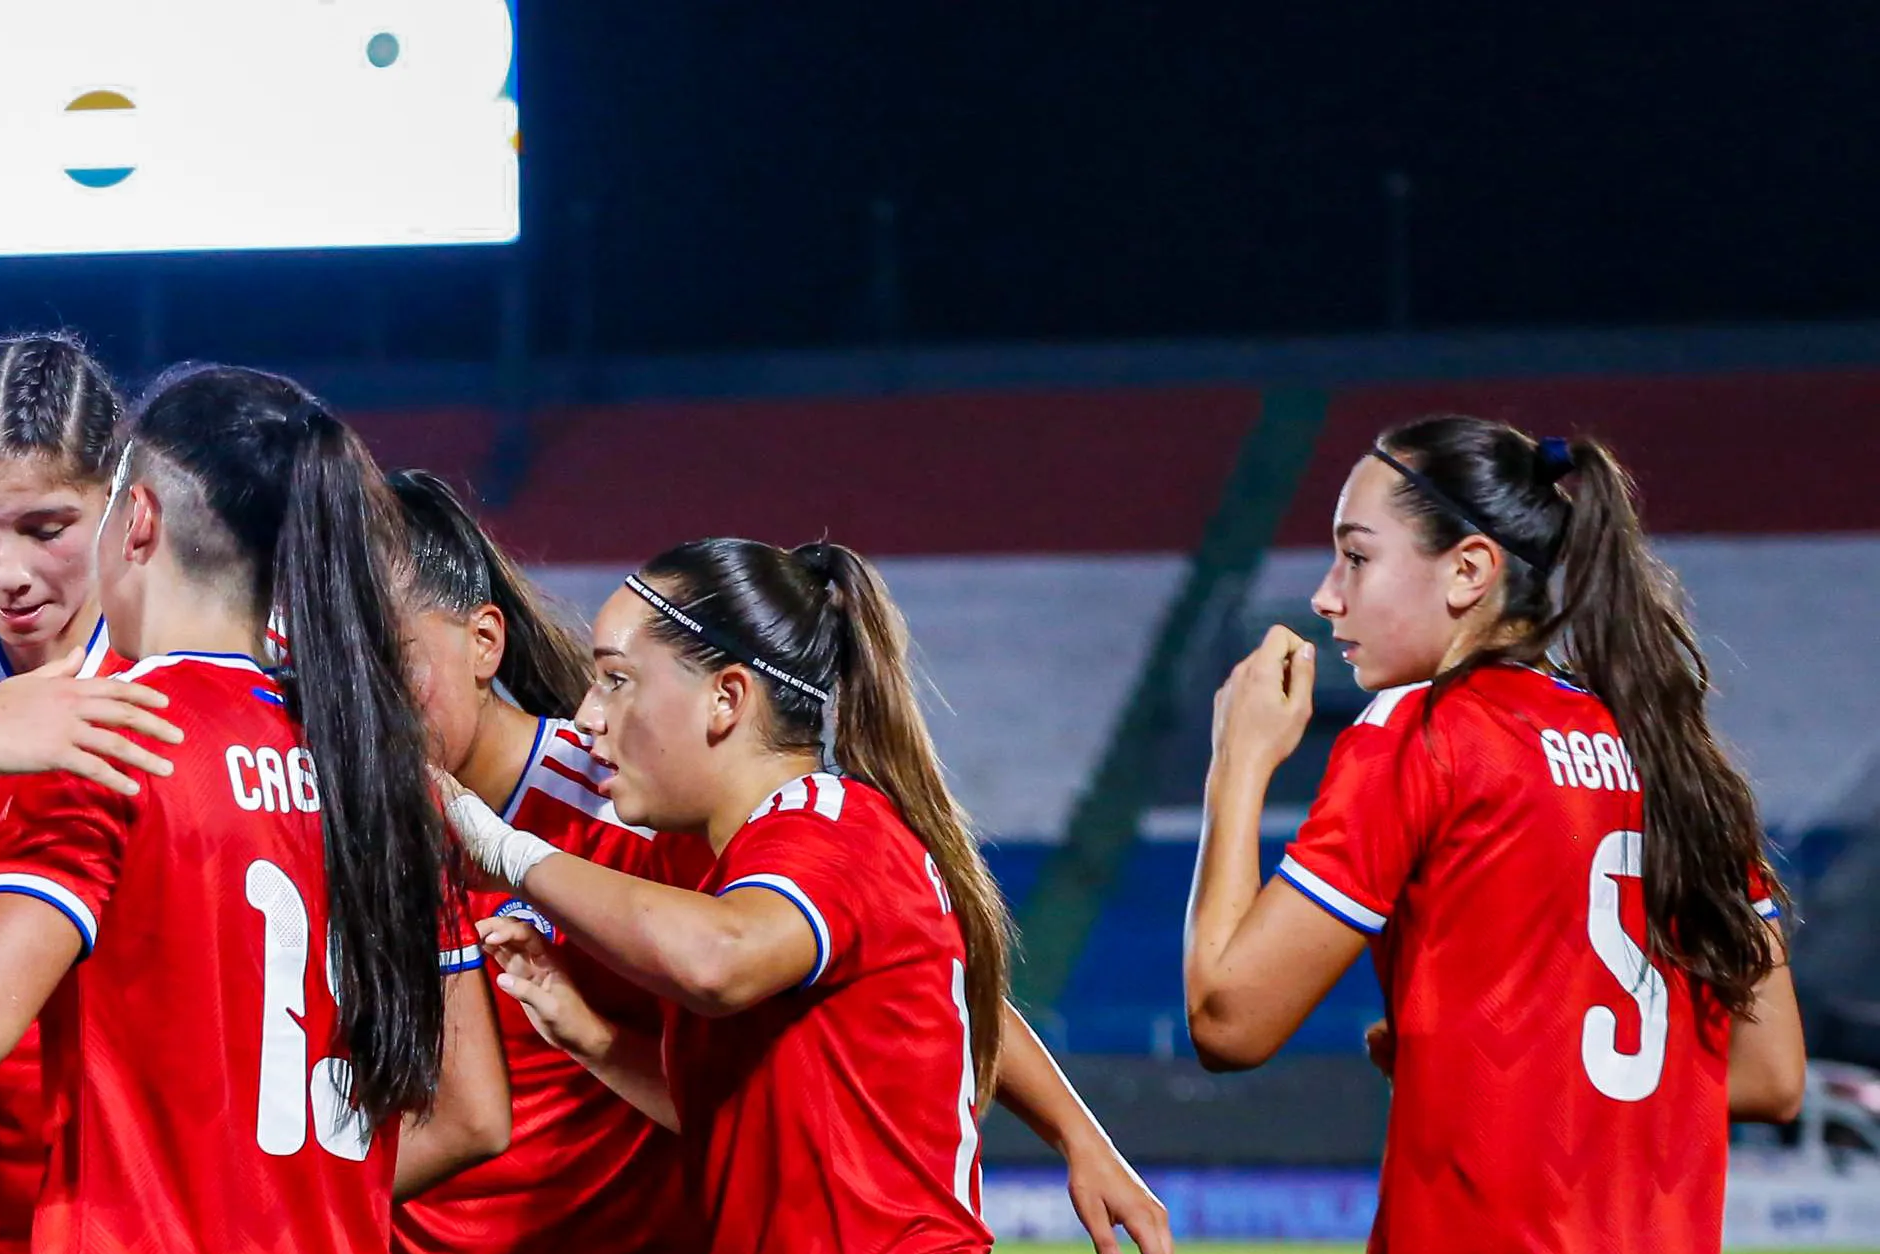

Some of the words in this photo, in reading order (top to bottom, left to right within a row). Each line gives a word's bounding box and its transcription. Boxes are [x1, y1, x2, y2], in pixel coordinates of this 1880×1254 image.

[668, 608, 703, 633] STREIFEN
[753, 658, 767, 670] DIE
[766, 665, 791, 683] MARKE
[790, 677, 803, 688] MIT
[1580, 829, 1670, 1103] 5
